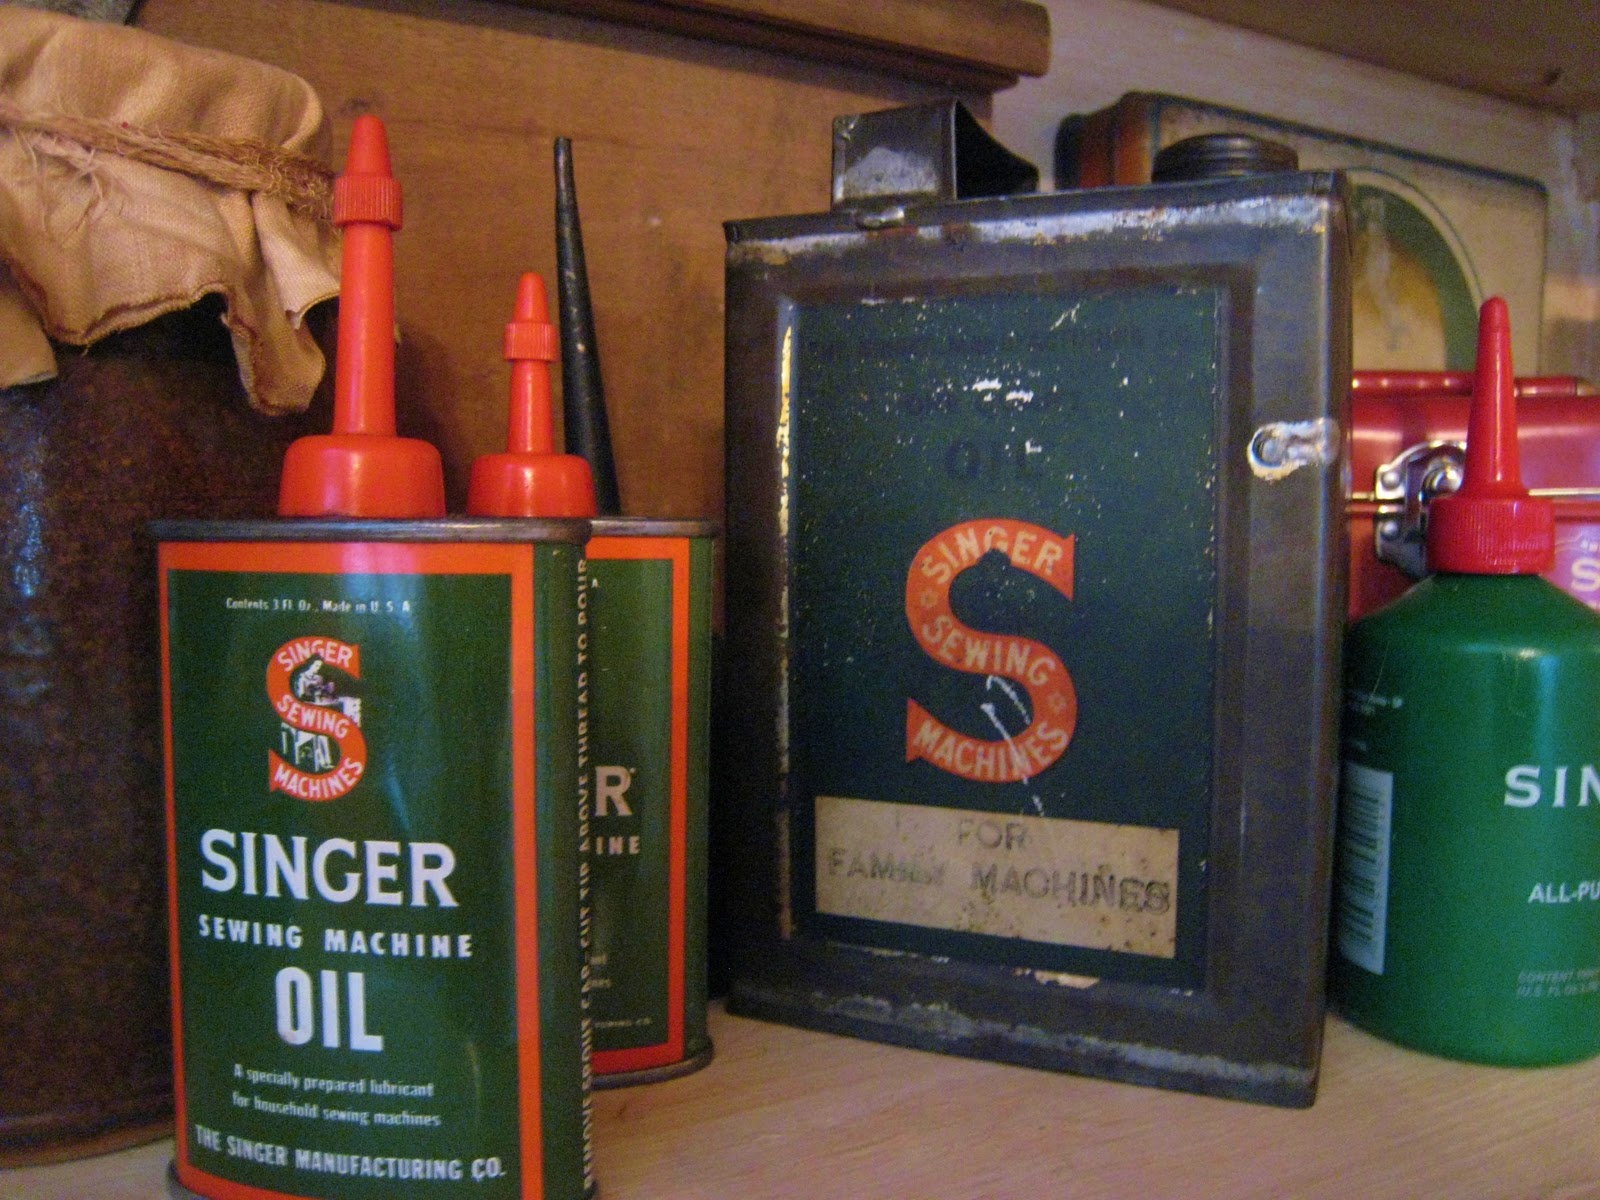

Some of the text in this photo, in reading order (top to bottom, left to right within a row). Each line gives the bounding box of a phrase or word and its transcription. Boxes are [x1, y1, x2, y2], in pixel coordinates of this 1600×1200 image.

[921, 526, 1063, 584] SINGER
[226, 597, 269, 610] Contents
[322, 599, 352, 612] Made
[577, 559, 588, 625] POUR
[277, 639, 354, 671] SINGER
[577, 633, 588, 665] TO
[922, 614, 1056, 687] SEWING
[276, 694, 350, 739] SEWING
[578, 672, 589, 767] THREAD
[914, 719, 1069, 777] MACHINES
[275, 757, 364, 798] MACHINES
[578, 773, 590, 852] ABOVE
[958, 818, 1029, 850] FOR
[201, 829, 459, 907] SINGER
[579, 861, 590, 900] TIP
[971, 861, 1172, 914] MACHINES
[199, 914, 473, 958] SEWING MACHINE
[275, 966, 384, 1052] OIL
[234, 1064, 435, 1098] A specially prepared lubricant
[231, 1089, 442, 1128] for household sewing machines
[194, 1124, 221, 1151] THE
[226, 1135, 288, 1166] SINGER
[295, 1148, 463, 1180] MANUFACTURING
